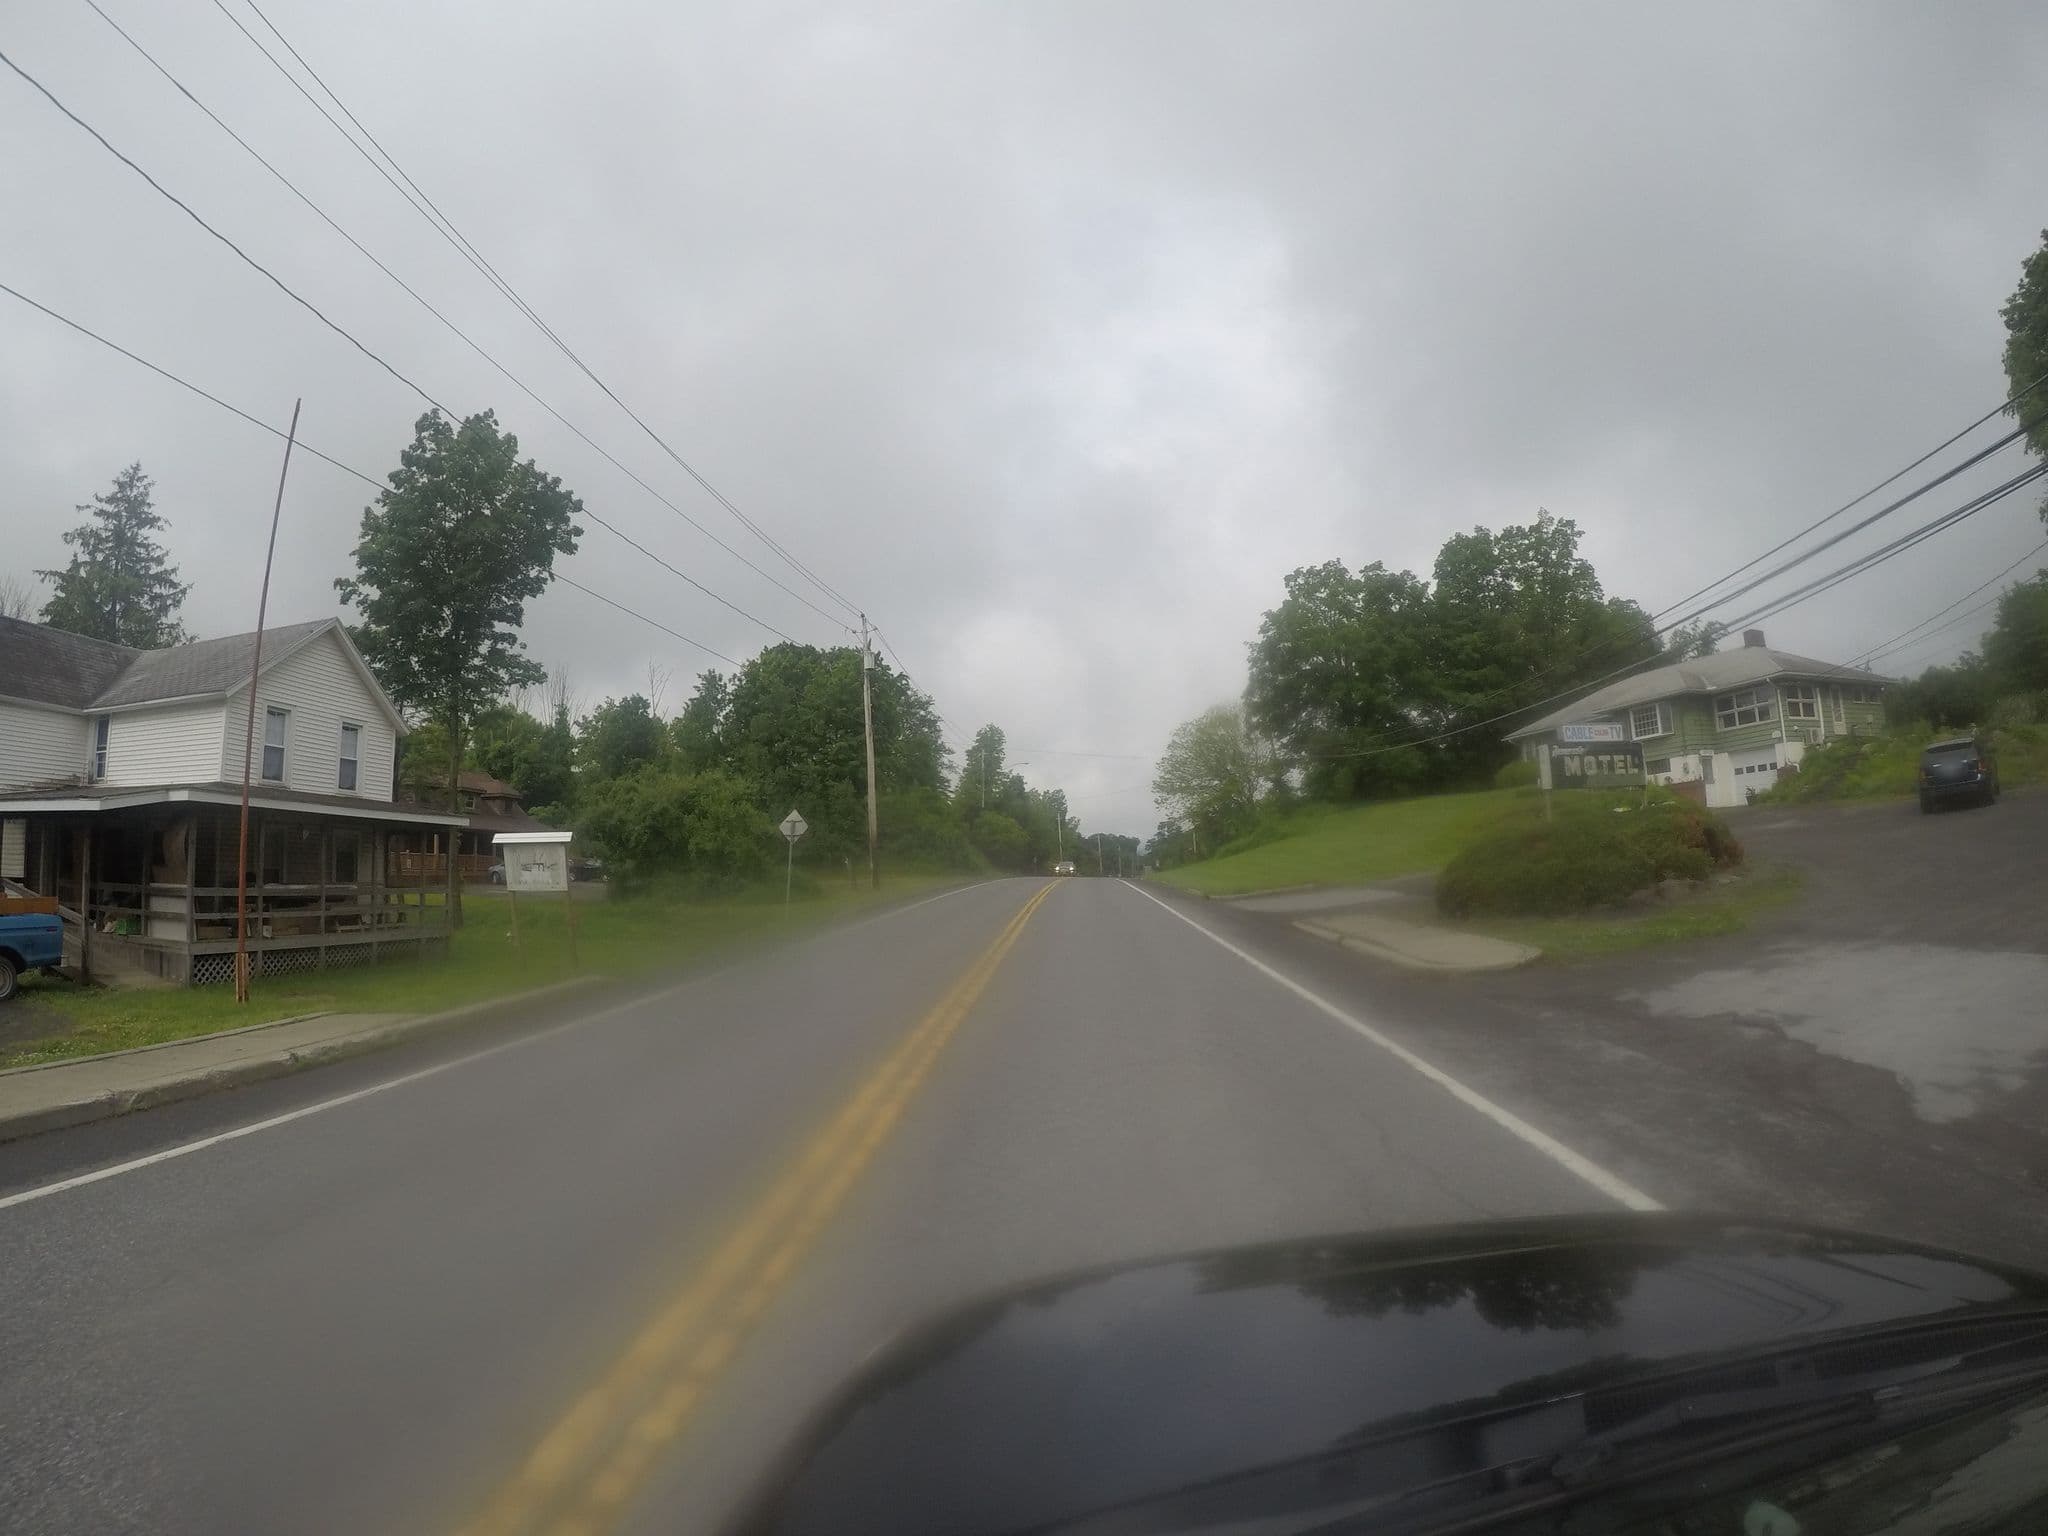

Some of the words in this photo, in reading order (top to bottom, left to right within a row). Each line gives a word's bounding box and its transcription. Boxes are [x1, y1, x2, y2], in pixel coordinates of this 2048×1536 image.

[1565, 726, 1592, 740] CABLE
[1608, 726, 1622, 739] TV
[1564, 755, 1639, 776] MOTEL
